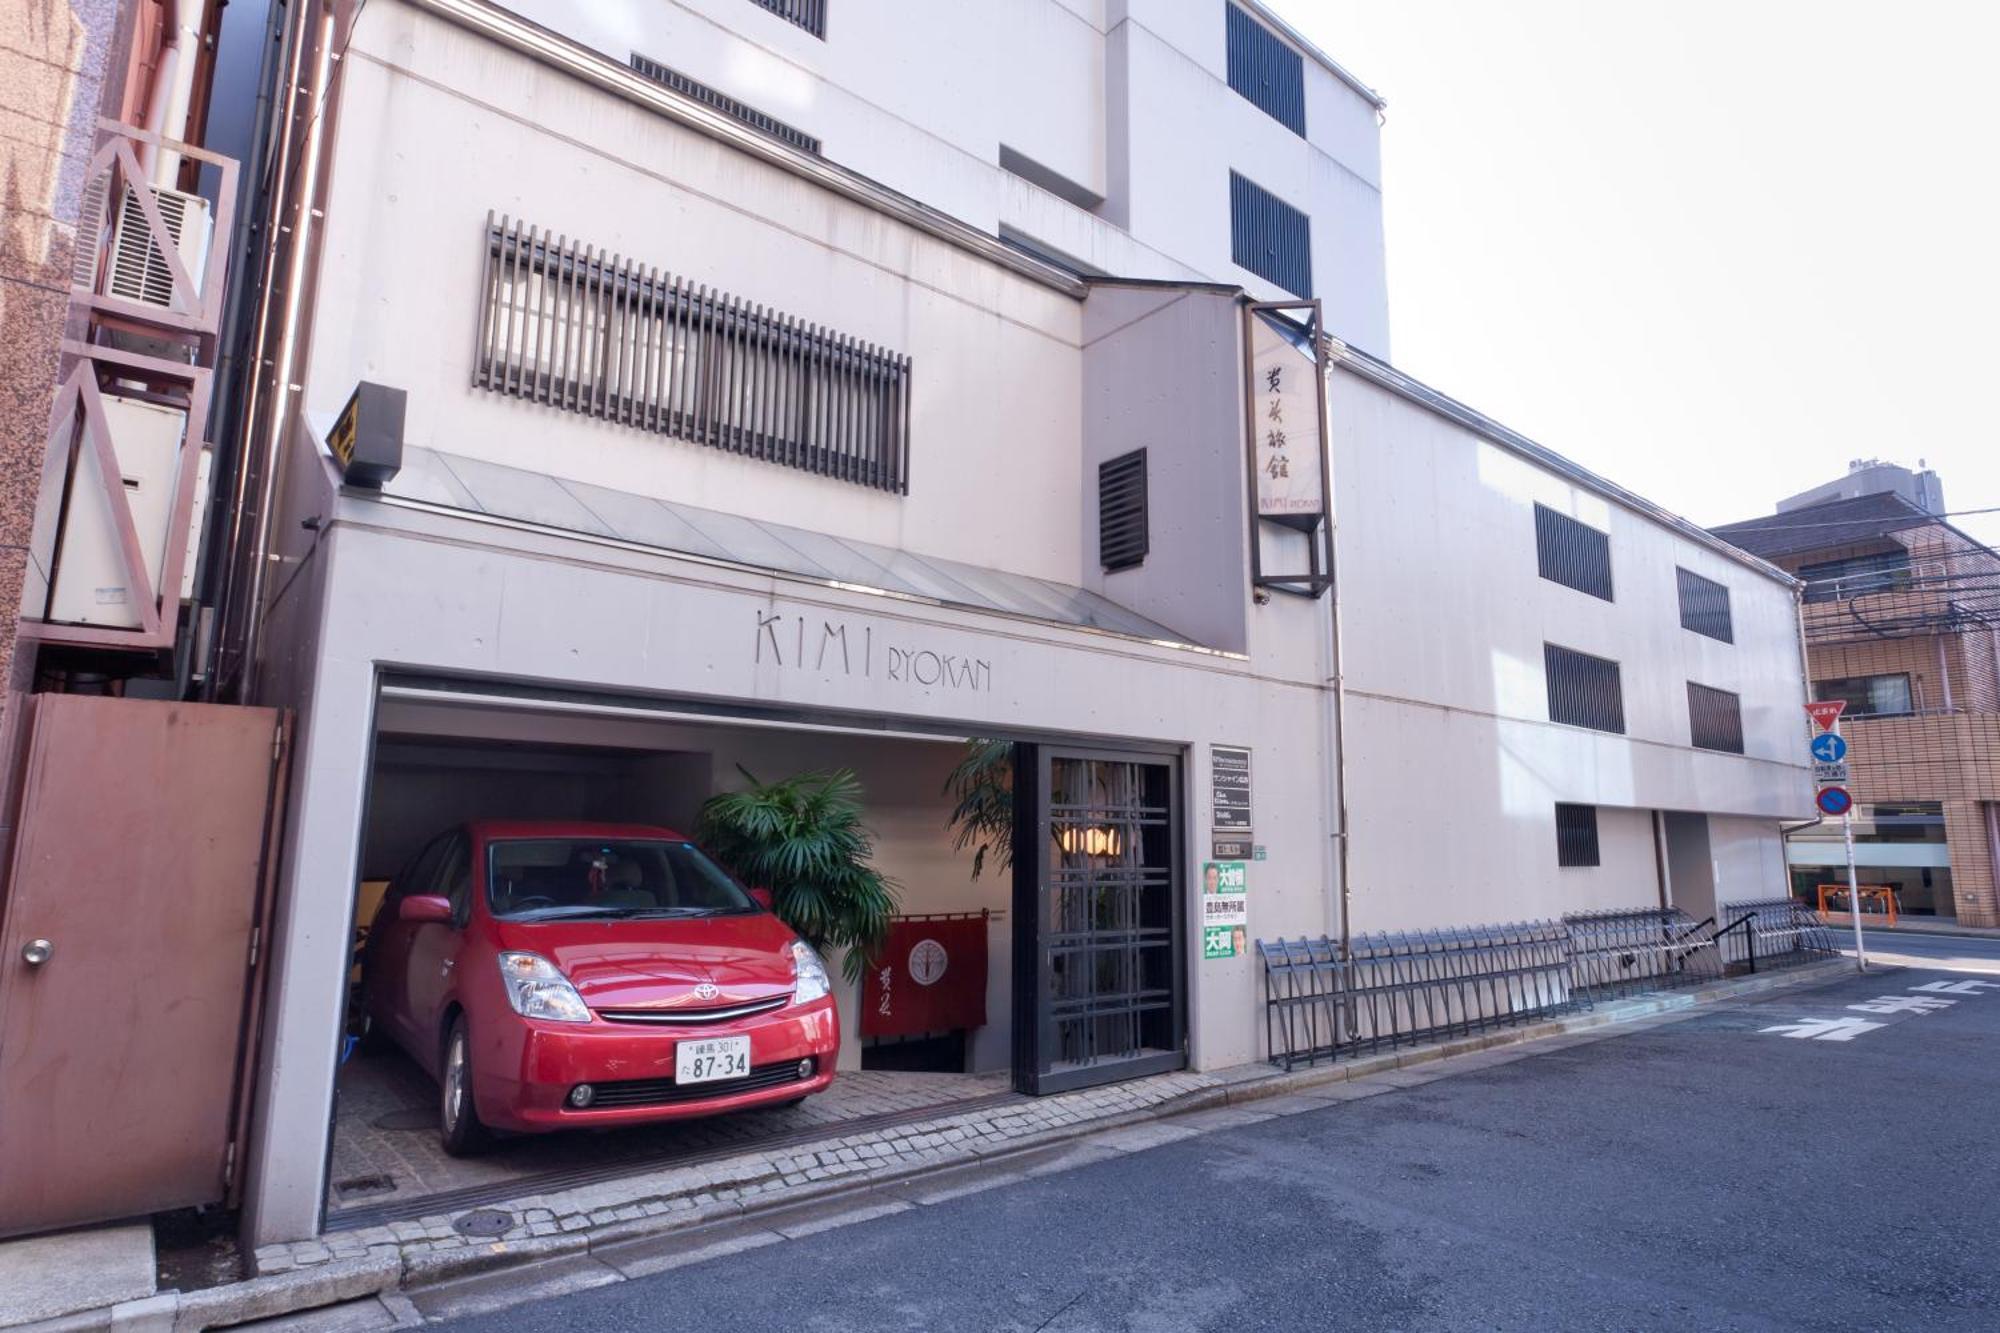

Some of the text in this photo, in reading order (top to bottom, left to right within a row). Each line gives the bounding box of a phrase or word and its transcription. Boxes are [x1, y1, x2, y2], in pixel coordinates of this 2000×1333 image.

[756, 610, 991, 692] KIMI RYOKAN
[1812, 706, 1838, 716] 止まれ
[718, 1041, 733, 1053] 301
[693, 1052, 746, 1078] 87-34
